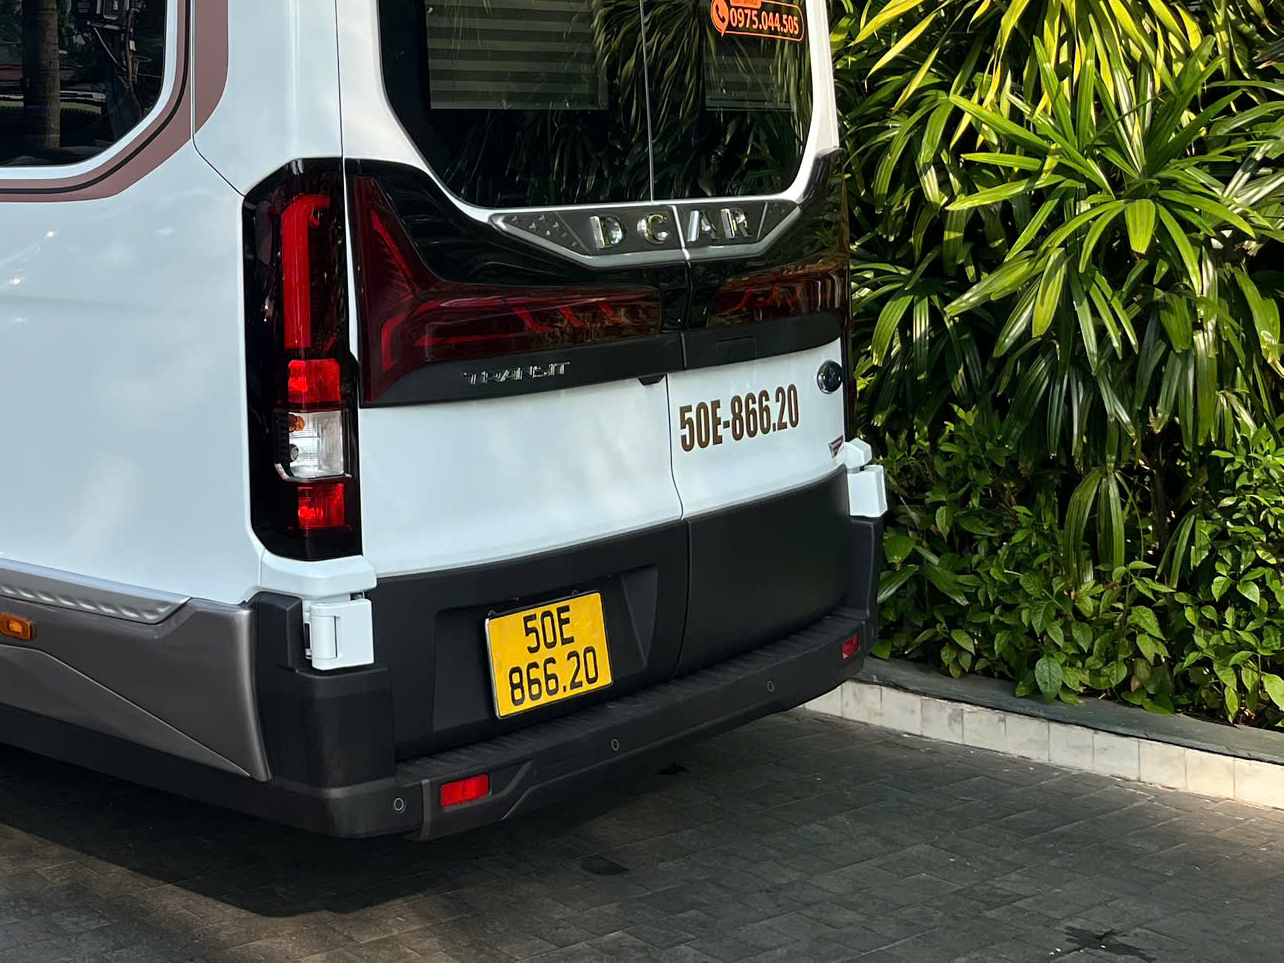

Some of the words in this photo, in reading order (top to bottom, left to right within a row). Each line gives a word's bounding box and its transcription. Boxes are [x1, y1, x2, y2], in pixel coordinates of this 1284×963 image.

[729, 8, 800, 35] 0975.044.505
[589, 207, 751, 249] DCAR
[679, 383, 800, 452] 50E-866.20
[522, 604, 575, 654] 50E
[508, 646, 599, 706] 866.20
